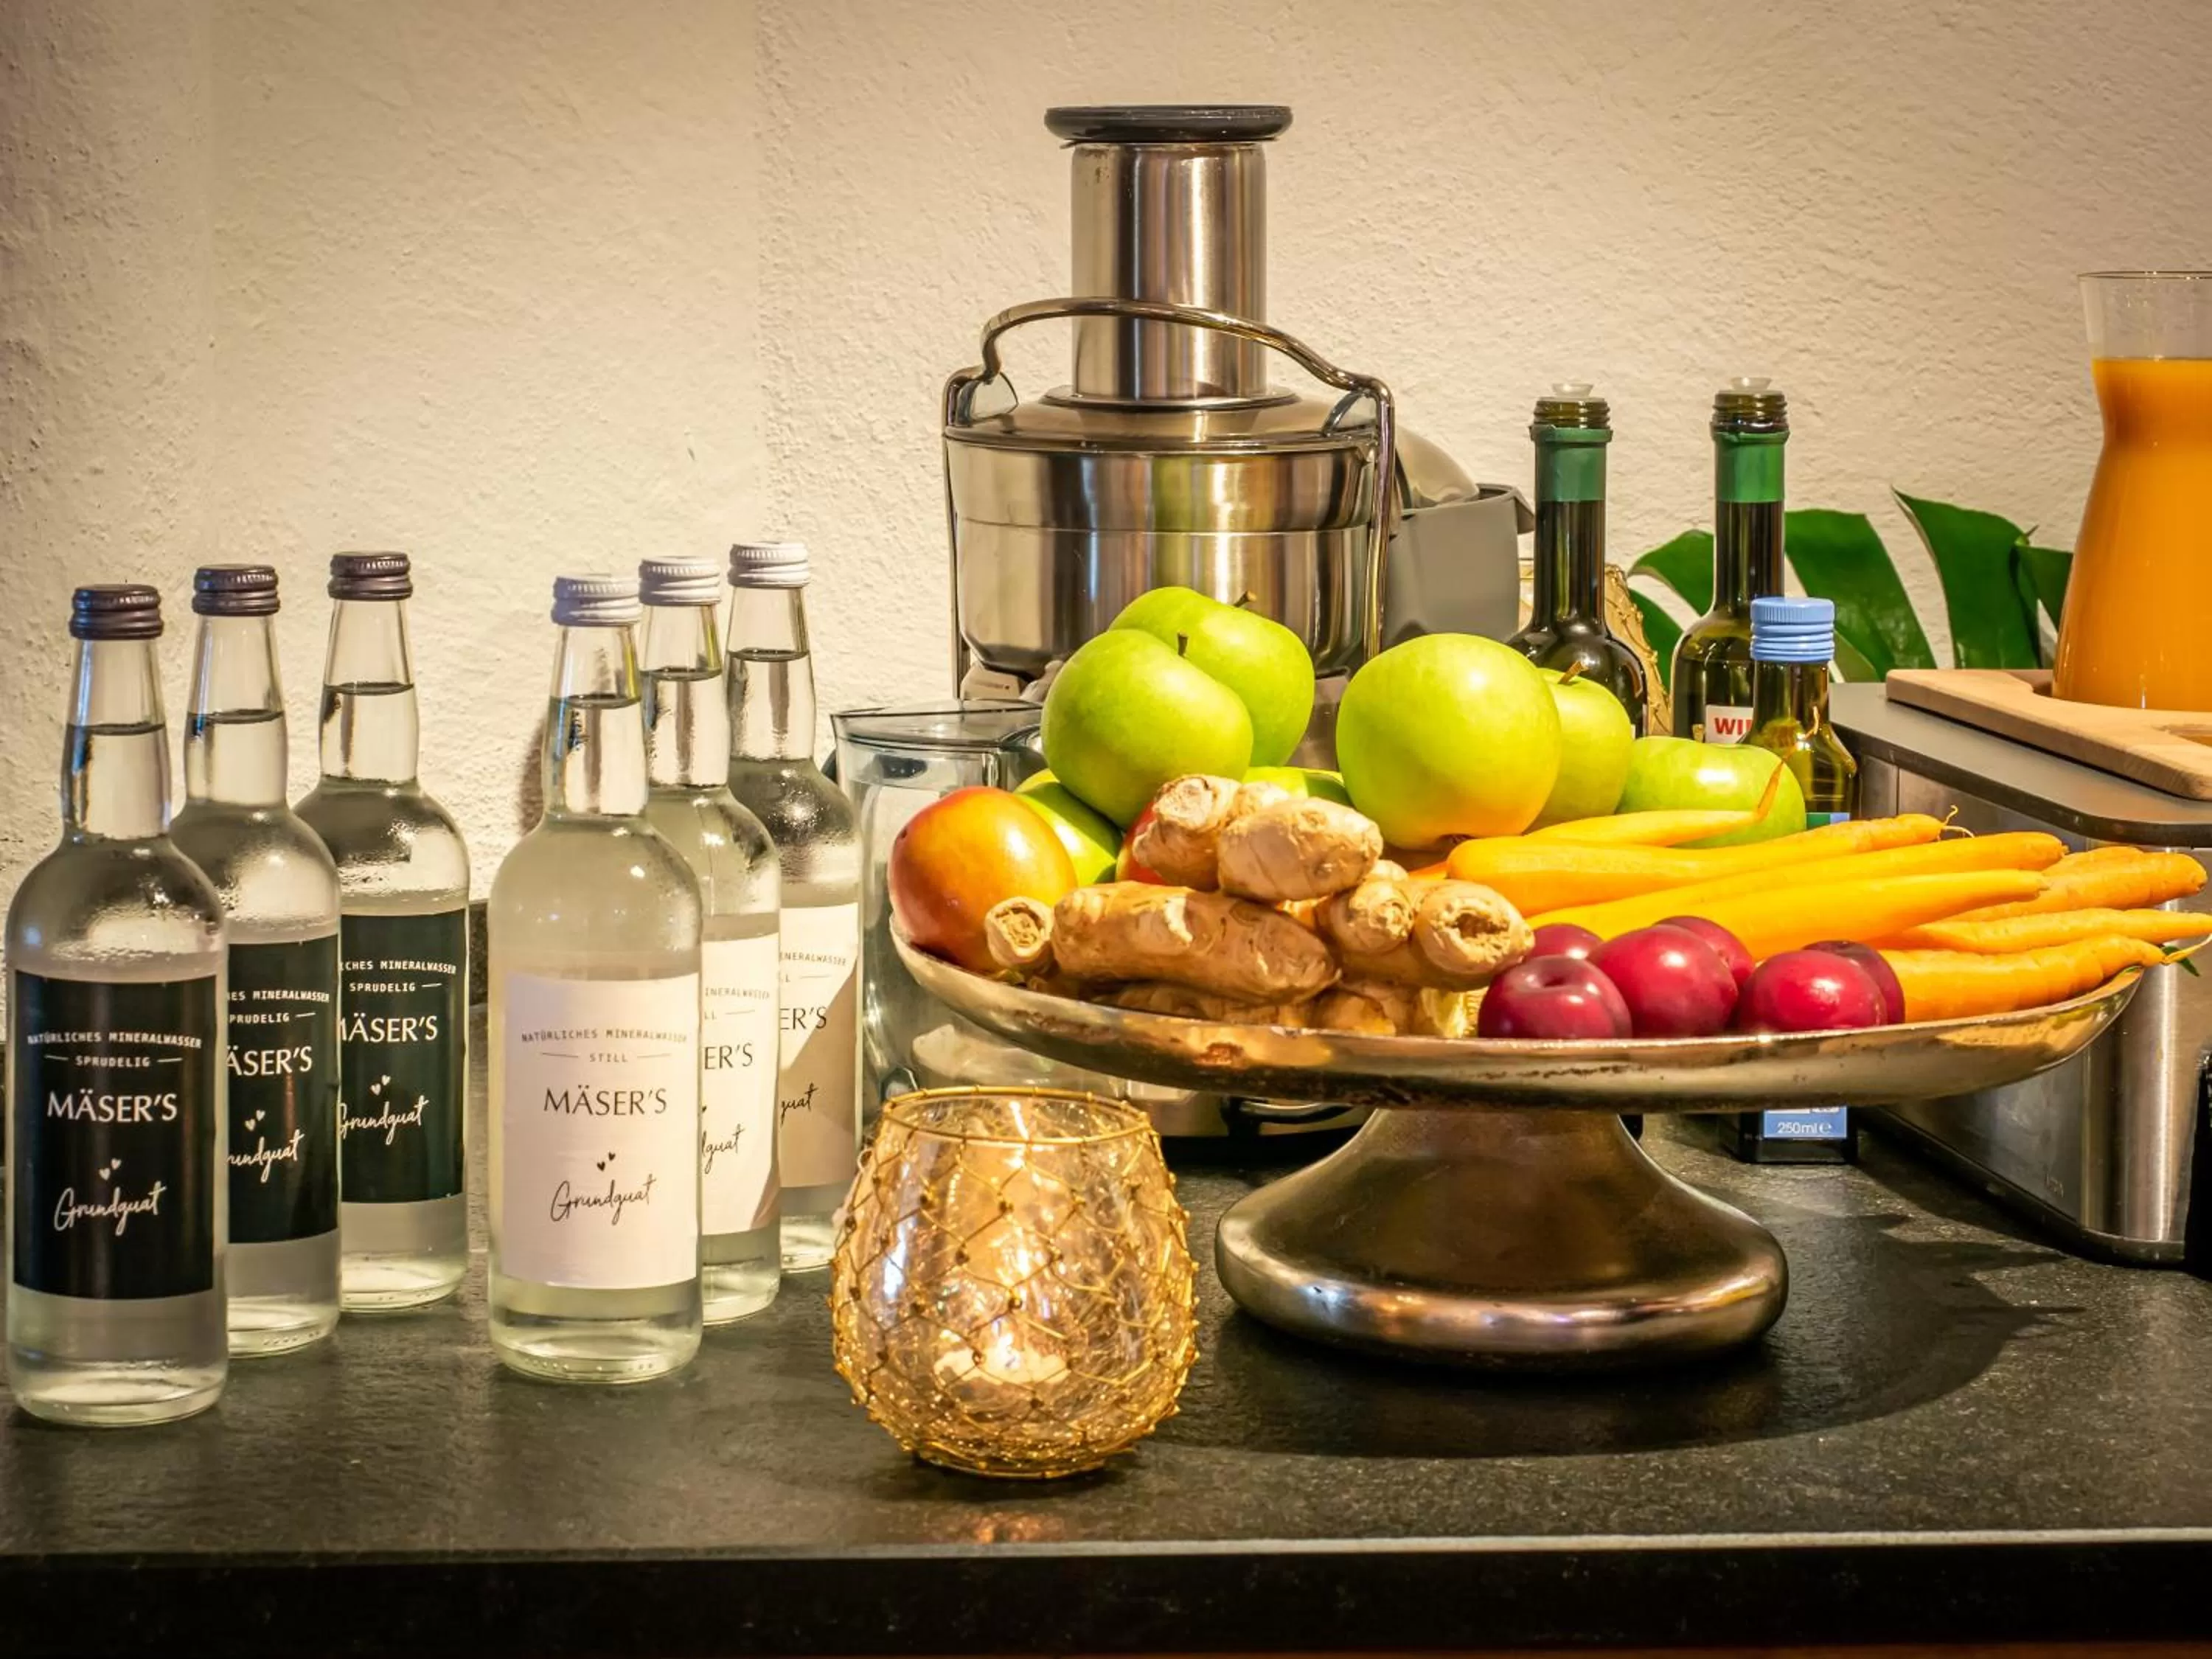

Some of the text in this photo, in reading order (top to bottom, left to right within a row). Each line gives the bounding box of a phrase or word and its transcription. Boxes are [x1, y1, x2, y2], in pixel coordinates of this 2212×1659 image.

[349, 982, 416, 992] SPRUDELIG
[229, 1012, 290, 1023] PRUDELIG
[779, 1007, 827, 1029] ER'S
[108, 1032, 202, 1049] MINERALWASSER
[521, 1029, 598, 1043] NATÜRLICHES
[74, 1055, 151, 1068] SPRUDELIG
[226, 1045, 313, 1076] ÄSER'S
[589, 1052, 628, 1062] STILL
[704, 1042, 753, 1070] ER'S
[47, 1088, 177, 1121] MÄSER'S
[543, 1085, 667, 1116] MÄSER'S
